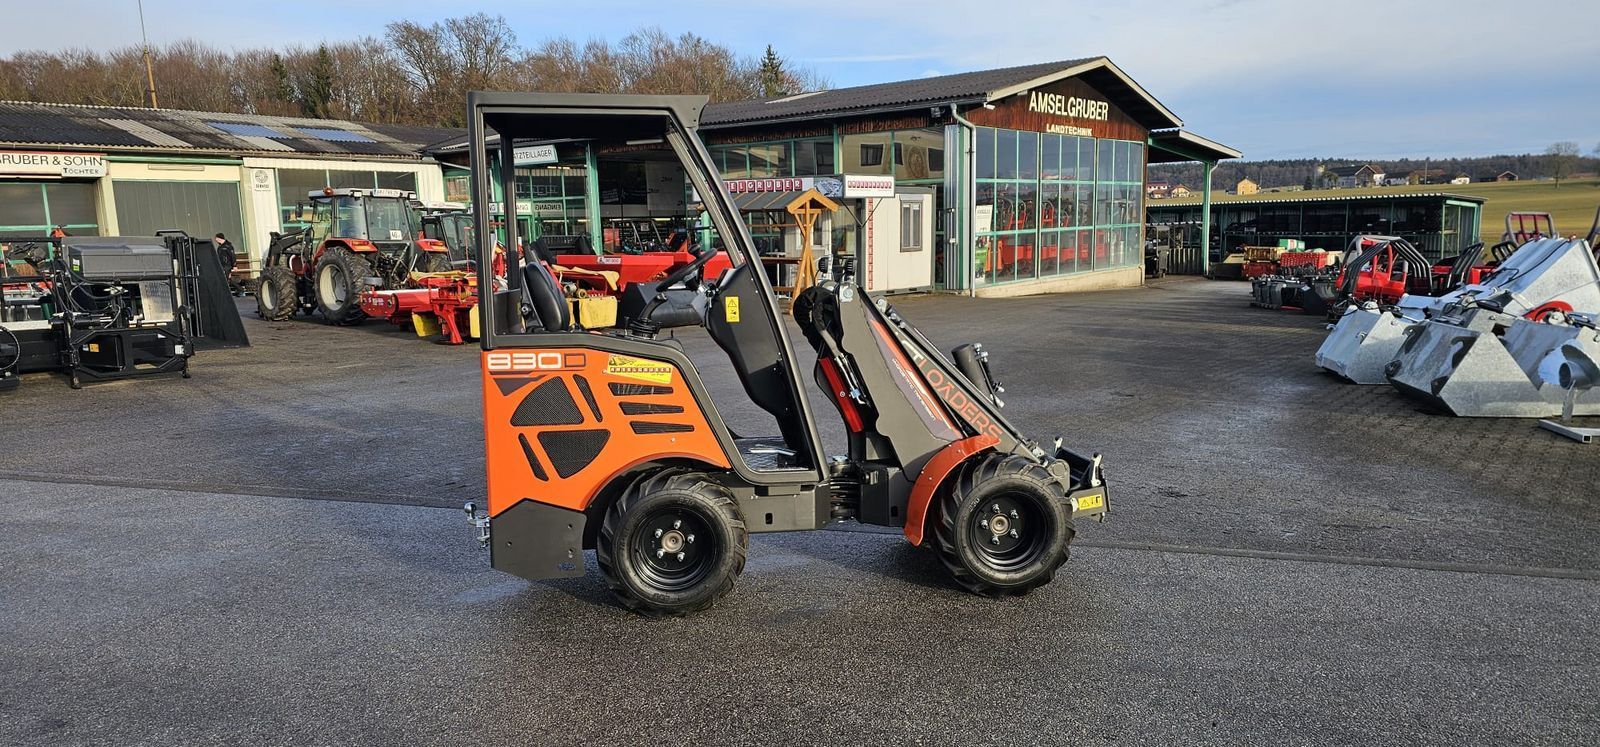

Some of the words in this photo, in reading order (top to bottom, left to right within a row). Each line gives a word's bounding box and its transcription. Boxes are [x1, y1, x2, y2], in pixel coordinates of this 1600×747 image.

[1028, 91, 1109, 121] AMSELGRUBER
[1046, 123, 1093, 137] LANDTECHNIK
[0, 154, 49, 165] RUBER
[52, 156, 61, 166] &
[63, 156, 103, 167] SOHN
[729, 179, 803, 193] ELGRUBER
